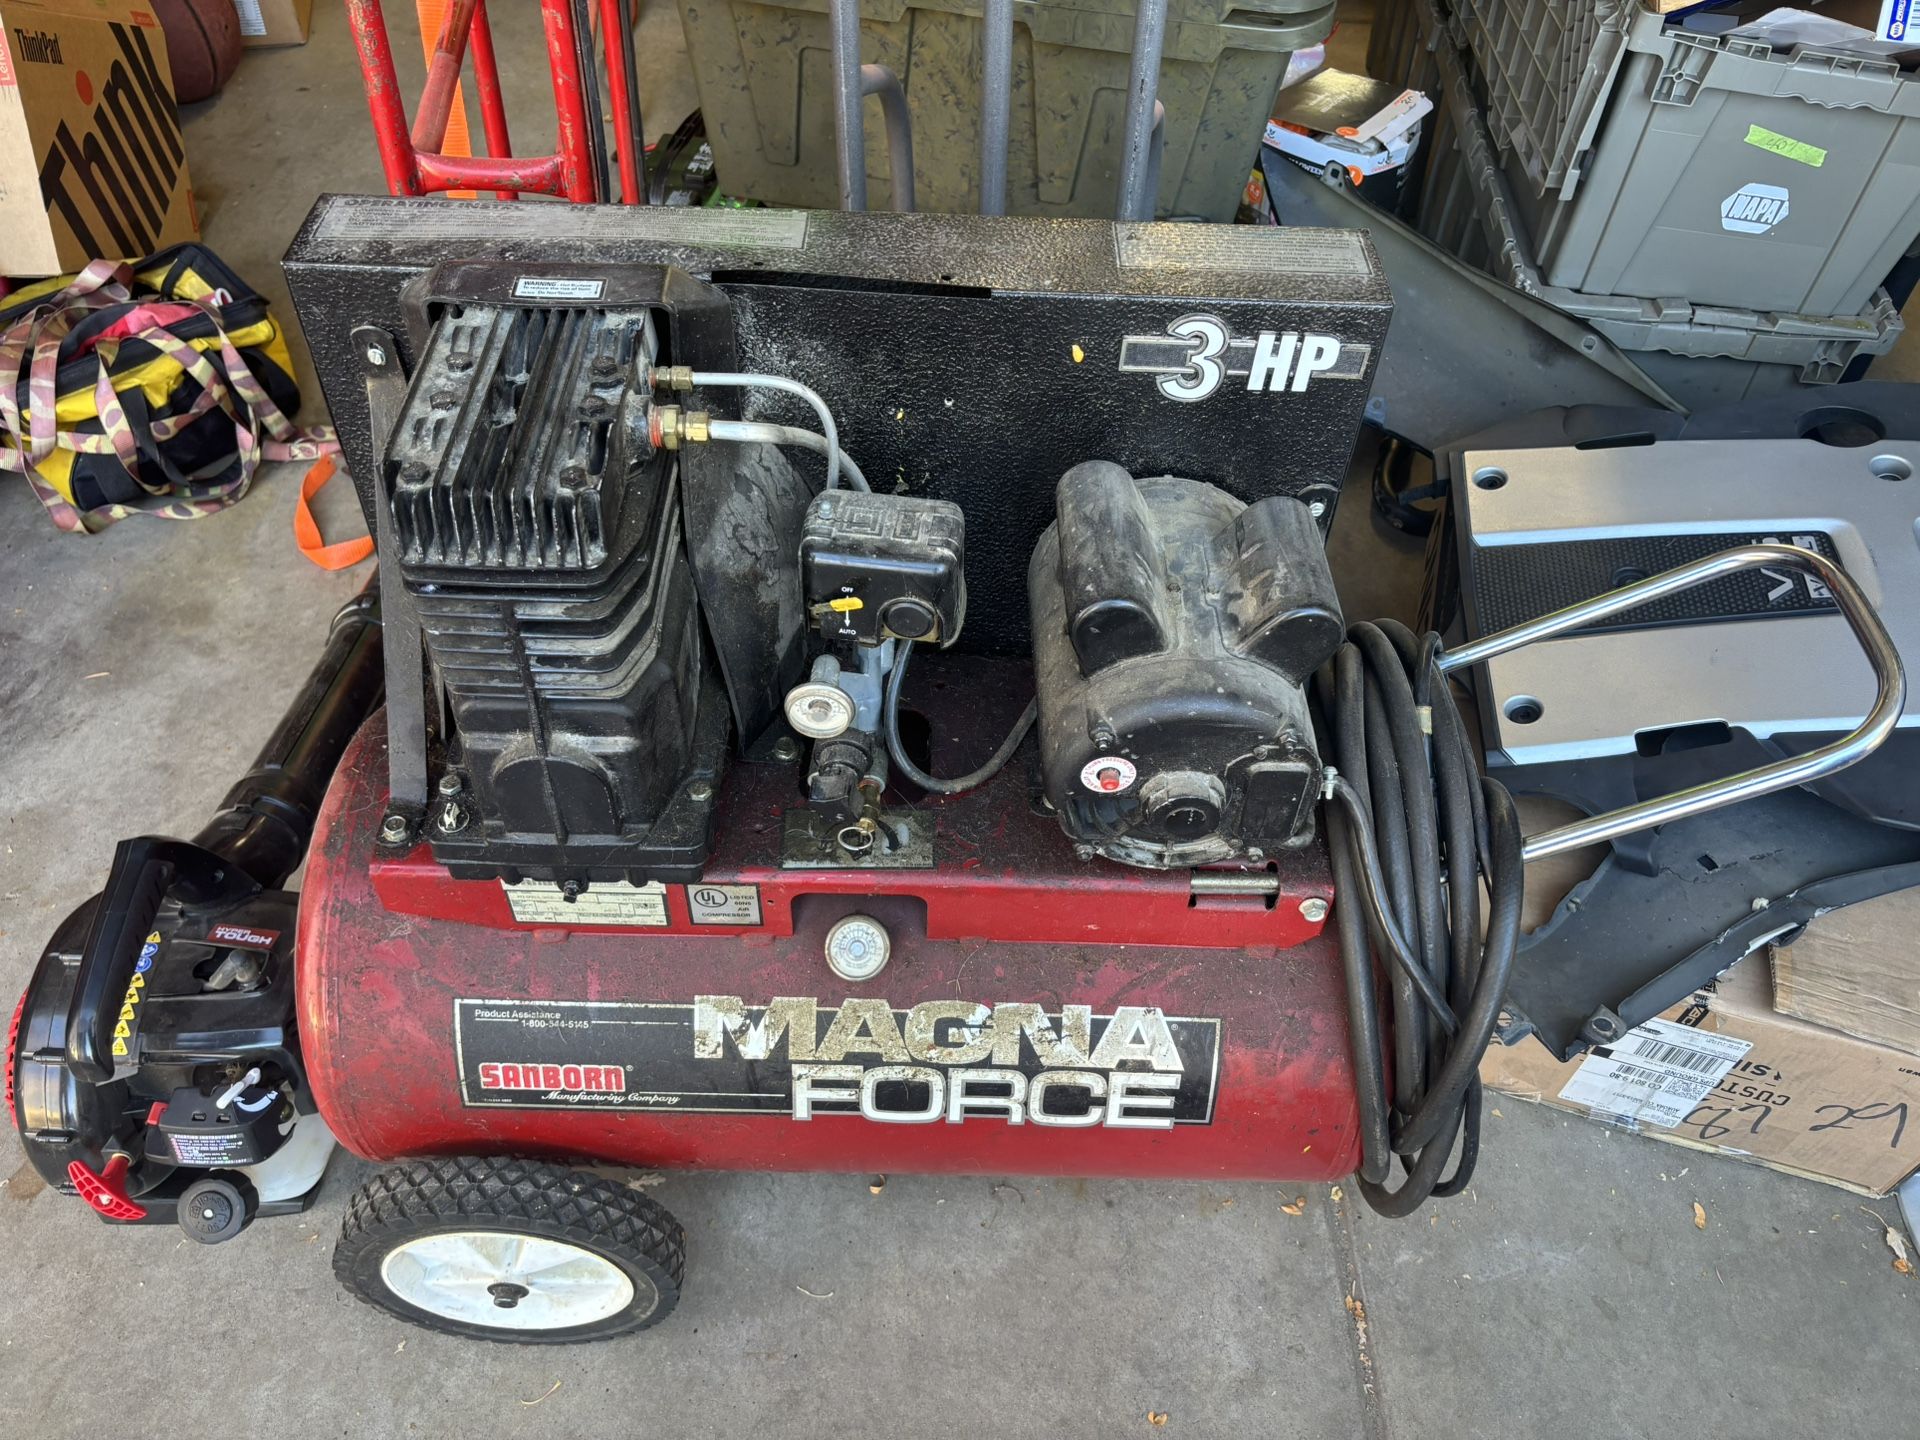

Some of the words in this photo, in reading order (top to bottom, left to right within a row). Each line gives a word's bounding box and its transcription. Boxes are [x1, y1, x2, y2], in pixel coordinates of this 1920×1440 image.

[14, 28, 64, 65] ThinkPad
[39, 21, 184, 257] Think
[1728, 194, 1782, 224] NAPA
[1156, 313, 1229, 400] 3
[1247, 332, 1342, 393] HP
[838, 627, 857, 636] AUTO
[701, 891, 721, 905] UL
[215, 930, 273, 945] TOUGH
[216, 926, 252, 934] HYPER
[475, 1009, 511, 1018] Product
[512, 1010, 562, 1019] Assistance
[694, 995, 1184, 1071] MAGNA
[479, 1062, 626, 1092] SANBORN
[1609, 1072, 1629, 1083] 9-80
[1630, 1078, 1647, 1086] 801
[1665, 1069, 1698, 1081] GROUND
[1699, 1077, 1716, 1086] UPS
[541, 1090, 626, 1103] Manufacturing
[628, 1092, 680, 1105] Company
[791, 1063, 1181, 1129] FORCE
